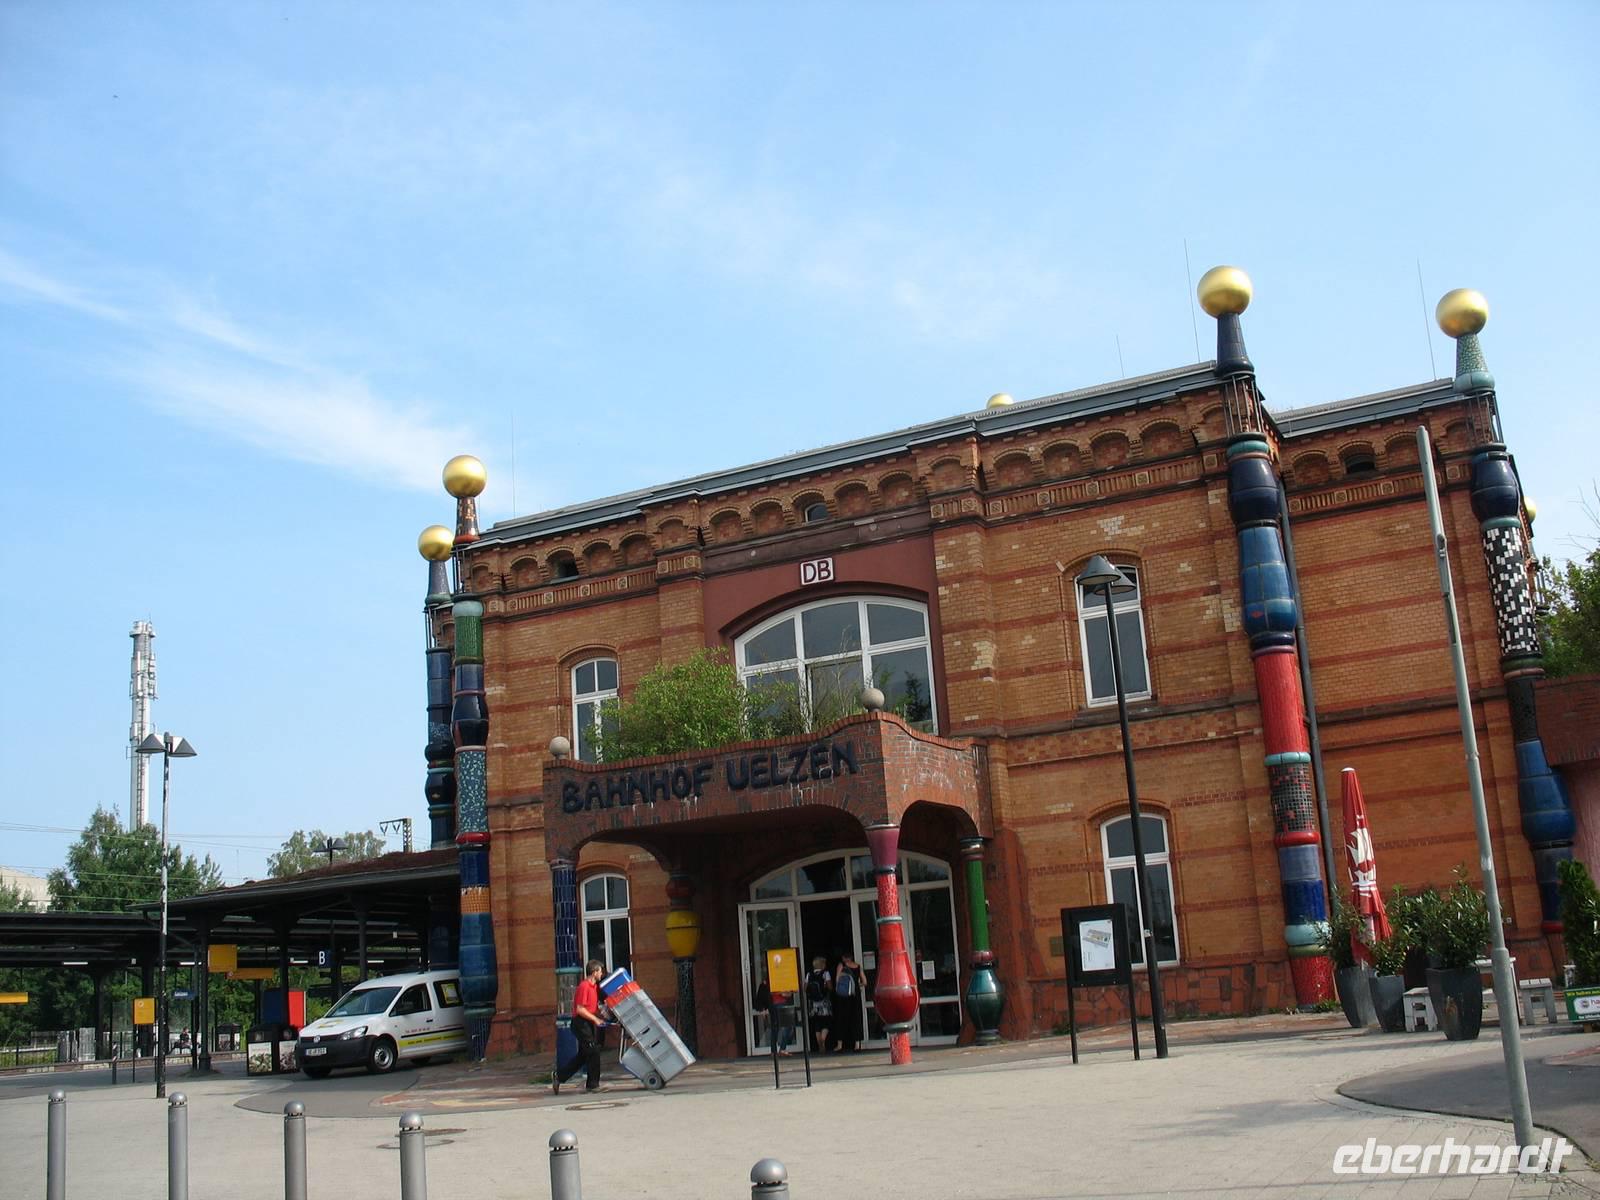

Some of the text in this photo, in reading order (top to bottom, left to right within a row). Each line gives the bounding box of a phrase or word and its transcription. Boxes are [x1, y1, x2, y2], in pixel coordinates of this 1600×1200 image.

[802, 560, 831, 583] DB
[561, 743, 859, 813] BAHNHOF UELZEN
[319, 951, 326, 965] B
